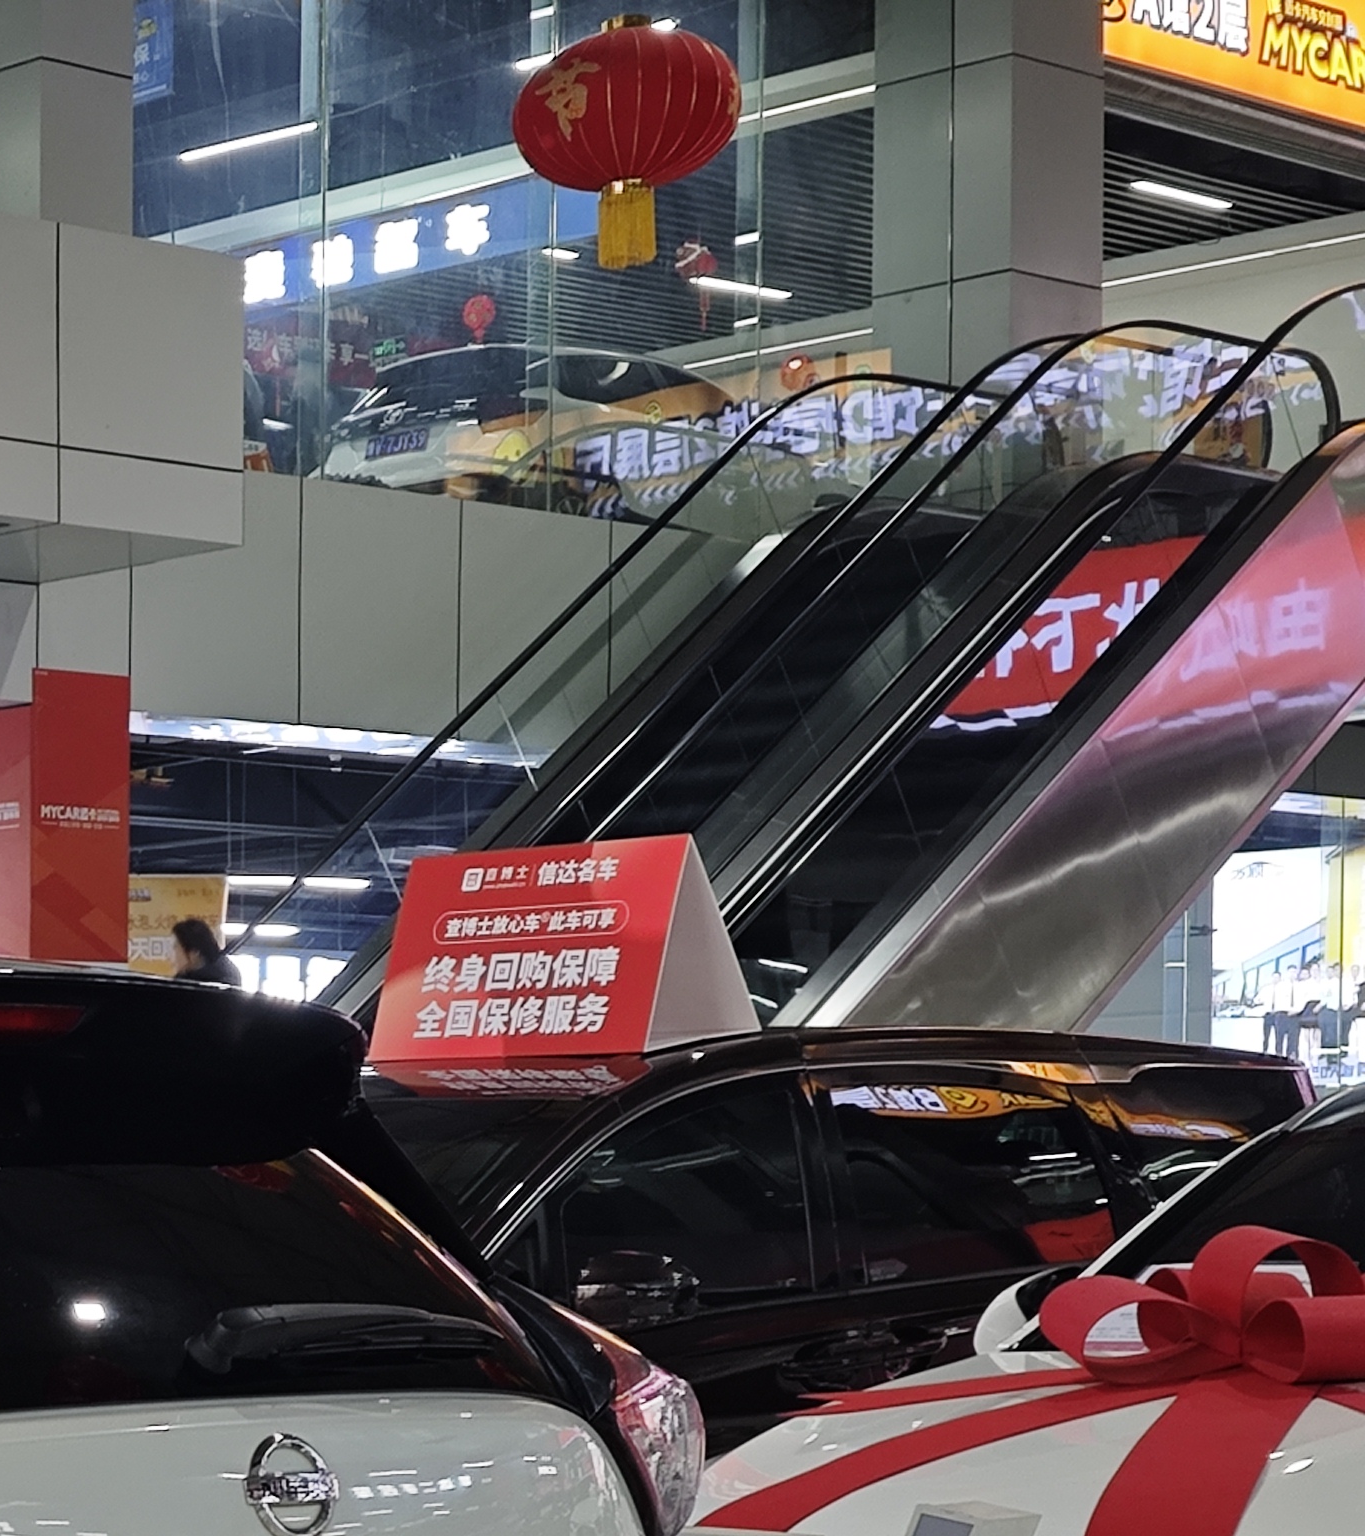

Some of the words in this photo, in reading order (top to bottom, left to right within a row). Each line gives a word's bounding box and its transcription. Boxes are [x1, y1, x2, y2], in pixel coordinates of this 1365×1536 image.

[536, 856, 620, 887] 信达名车
[421, 945, 621, 994] 终身回购保障
[413, 992, 610, 1040] 全国保修服务
